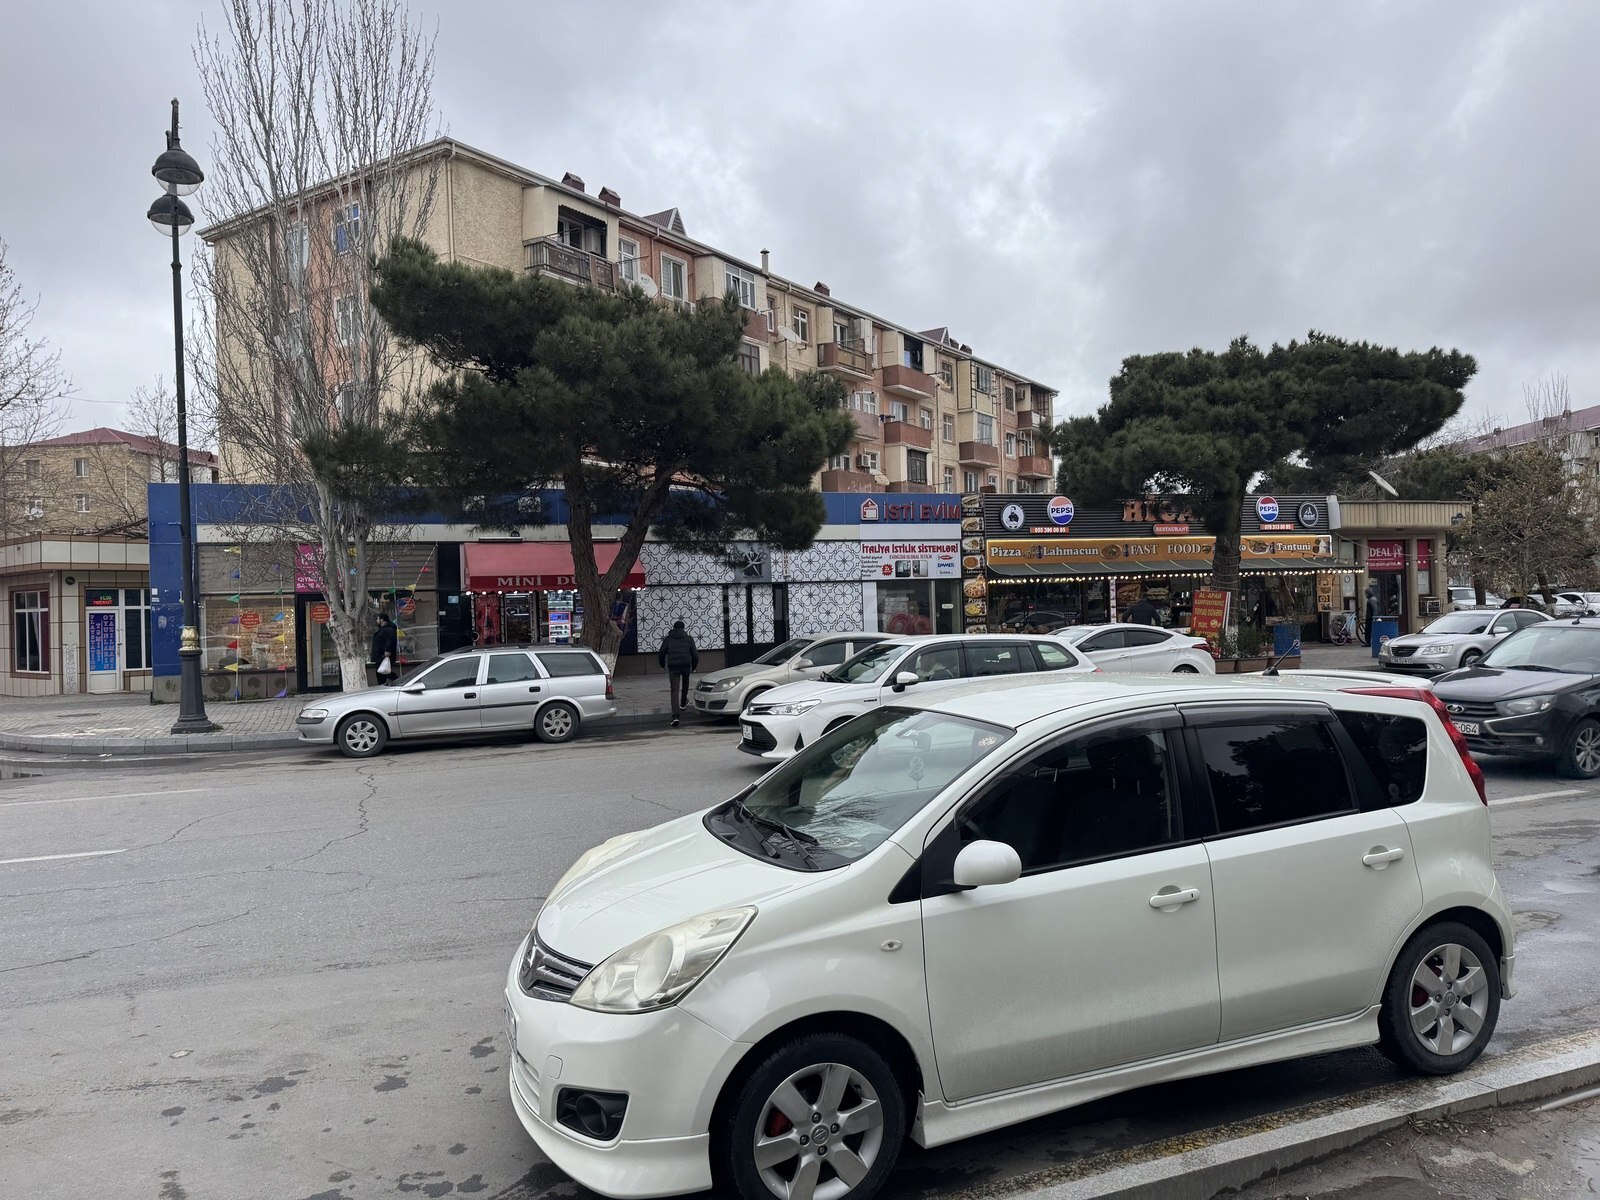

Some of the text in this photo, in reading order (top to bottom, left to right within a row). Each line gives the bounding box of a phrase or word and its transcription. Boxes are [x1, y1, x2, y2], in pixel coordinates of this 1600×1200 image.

[884, 501, 960, 519] İSTİ EVİM
[862, 543, 889, 553] İTALİYA
[918, 543, 958, 553] SİSTEMLƏRİ
[991, 547, 1021, 556] Pizza
[1043, 547, 1099, 556] Lahmacun
[1131, 544, 1201, 555] FAST FOOD
[1277, 543, 1311, 551] Tantuni
[497, 575, 542, 586] MİNİ
